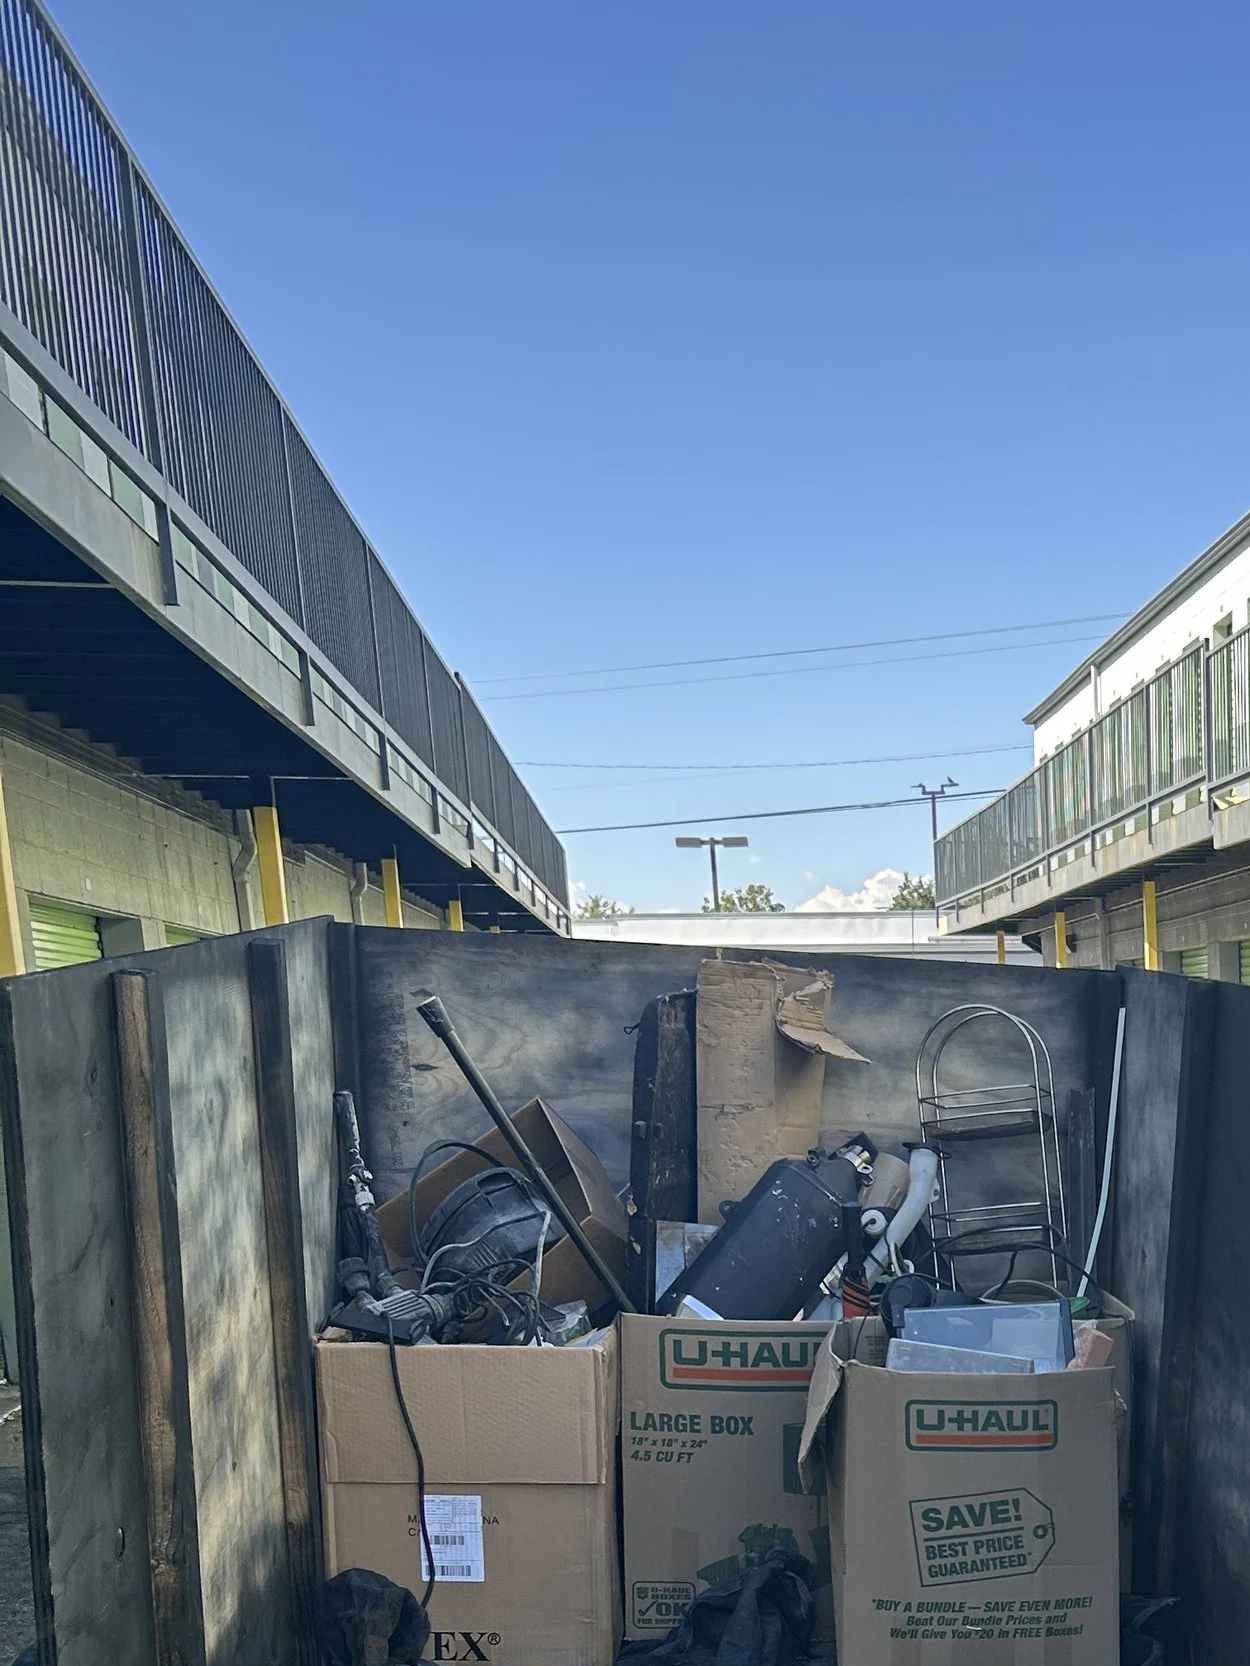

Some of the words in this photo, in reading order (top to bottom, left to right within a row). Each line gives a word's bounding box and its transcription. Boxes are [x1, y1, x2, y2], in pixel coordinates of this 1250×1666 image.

[630, 1411, 701, 1434] LARGE
[710, 1416, 754, 1436] BOX
[916, 1408, 1049, 1432] U-HAUL
[631, 1436, 648, 1445] 18"
[660, 1438, 678, 1447] 18"
[680, 1440, 688, 1448] x
[690, 1440, 708, 1448] 24"
[630, 1450, 652, 1462] 4.5
[656, 1451, 673, 1462] CU
[677, 1452, 694, 1463] FT
[922, 1498, 1022, 1532] SAVE!
[925, 1542, 968, 1560] BEST
[974, 1535, 1024, 1555] PRICE
[656, 1602, 689, 1616] OK
[904, 1602, 912, 1612] A
[916, 1602, 965, 1613] BUNDLE
[983, 1601, 1016, 1612] SAVE
[1019, 1600, 1051, 1612] EVEN
[1054, 1596, 1093, 1610] MORE!
[906, 1616, 933, 1626] Beat
[937, 1616, 958, 1626] Our
[961, 1615, 1002, 1626] Bundle
[1006, 1614, 1042, 1625] Prices
[1045, 1613, 1067, 1624] and
[890, 1628, 917, 1639] We'll
[921, 1629, 946, 1640] Give
[951, 1628, 972, 1639] You
[974, 1628, 994, 1639] $20
[1013, 1628, 1042, 1638] FREE
[1045, 1625, 1083, 1637] Boxes!
